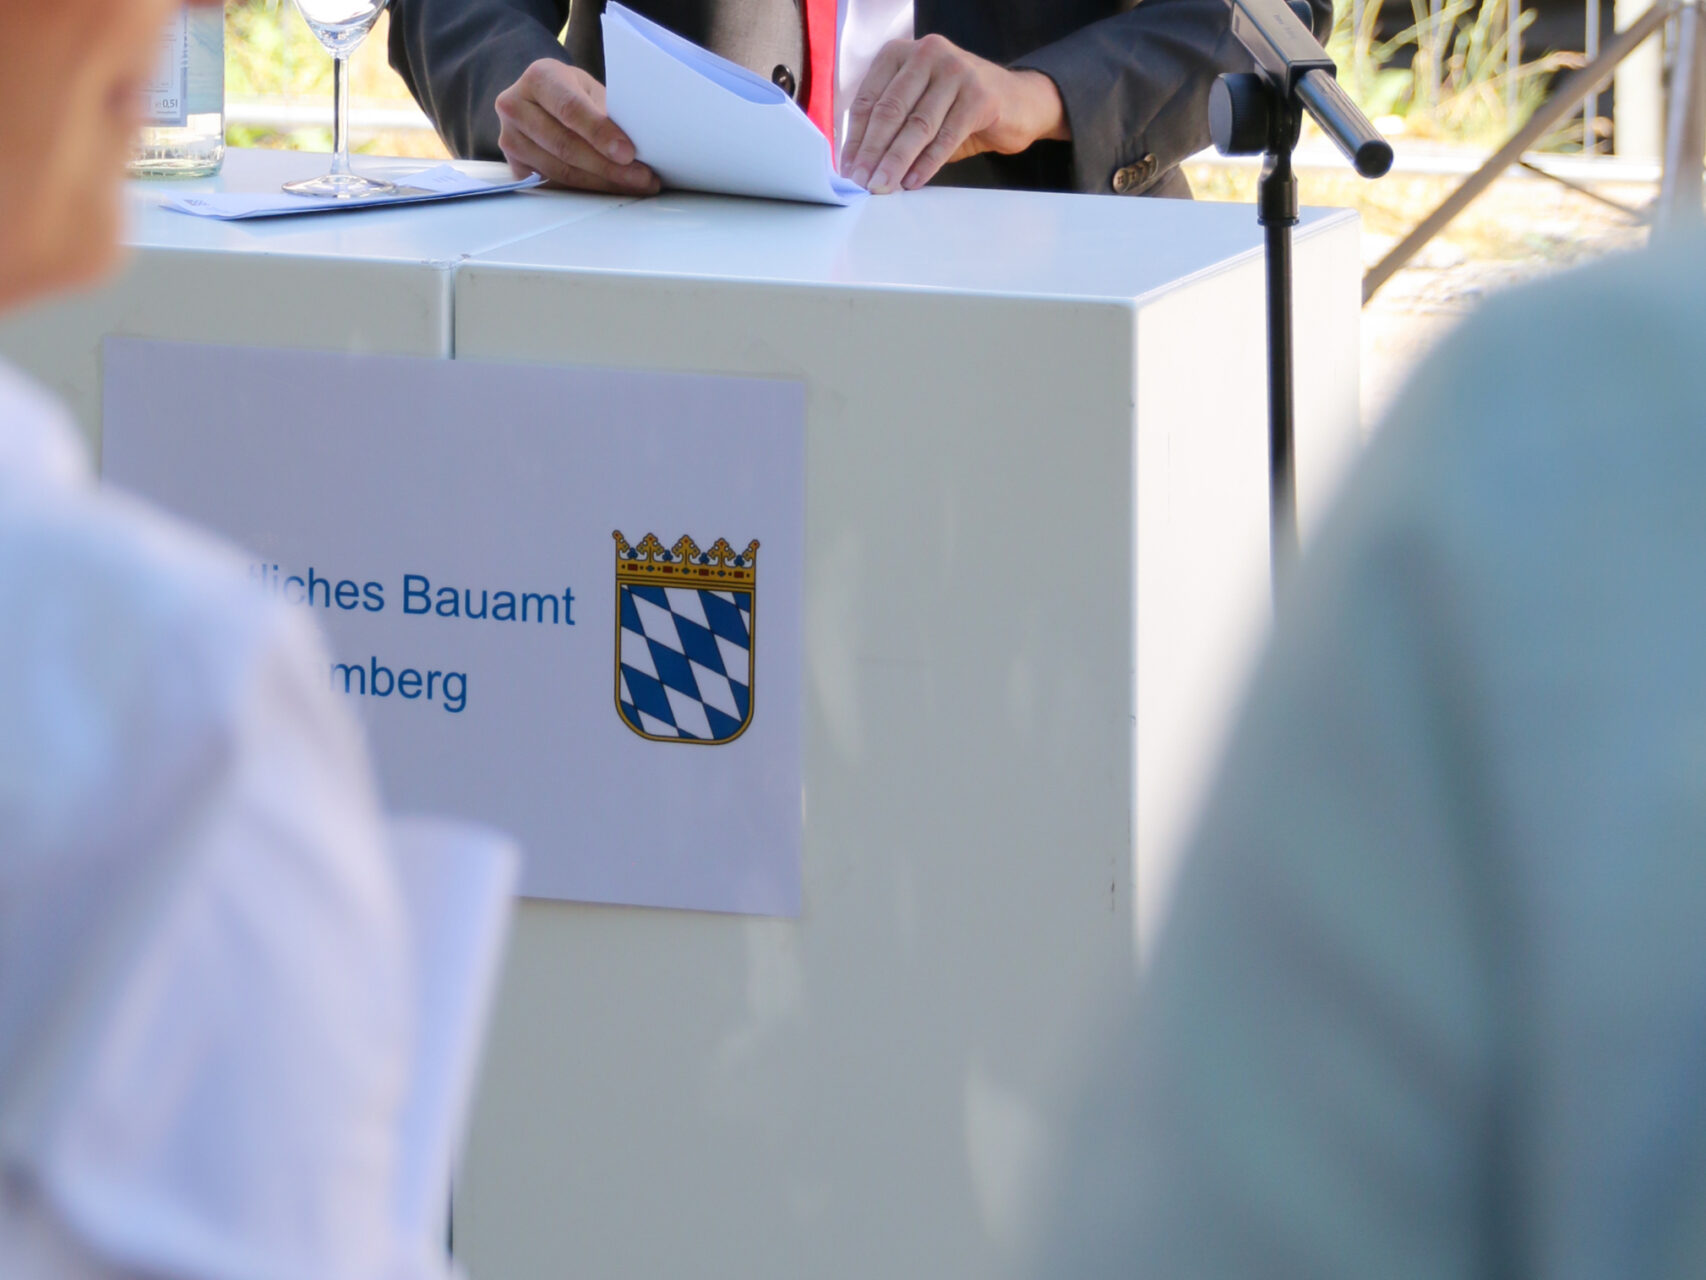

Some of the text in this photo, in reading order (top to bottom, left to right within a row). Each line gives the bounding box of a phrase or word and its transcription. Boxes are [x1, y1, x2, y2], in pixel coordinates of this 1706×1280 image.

[251, 562, 576, 626] liches Bauamt
[330, 656, 468, 713] mberg
